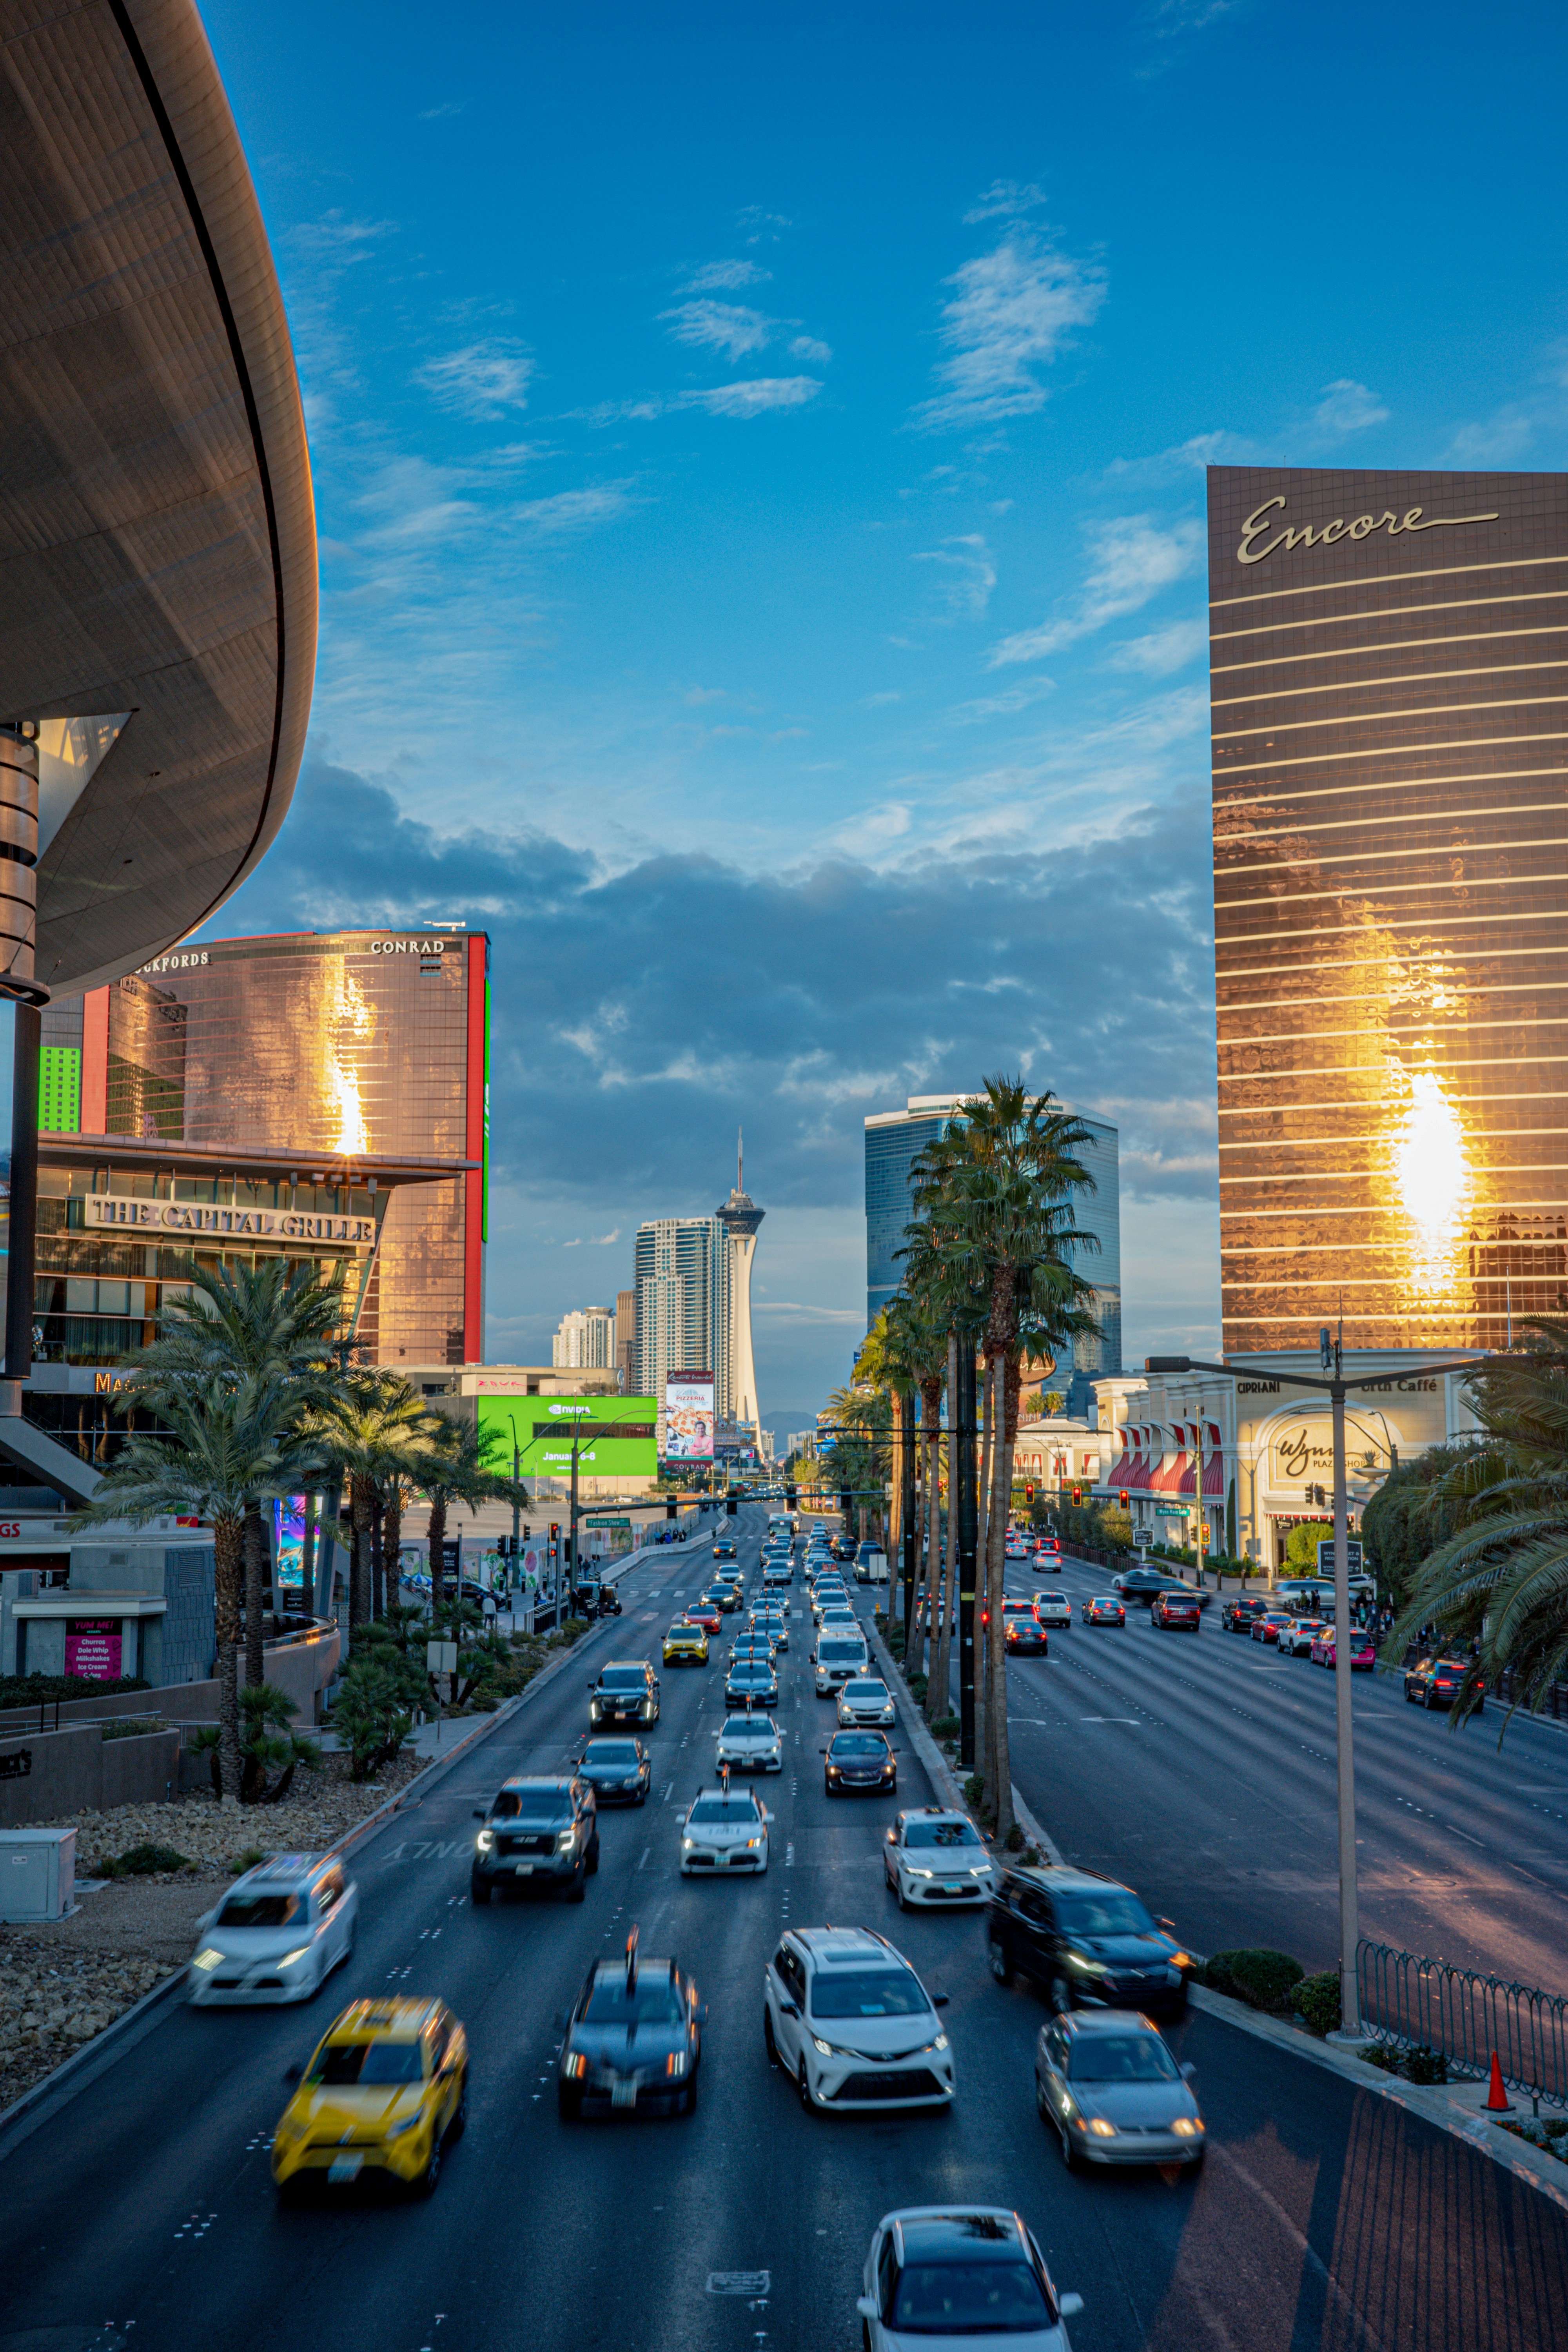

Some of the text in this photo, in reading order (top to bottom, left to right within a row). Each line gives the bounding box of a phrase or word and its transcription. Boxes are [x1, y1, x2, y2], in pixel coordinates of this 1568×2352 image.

[1238, 496, 1499, 564] Encore
[371, 941, 444, 953] CONRAD
[93, 1200, 372, 1241] THE CAPITAL GRILLE
[1238, 1382, 1280, 1394] CIPRIANI
[1397, 1379, 1437, 1391] Caffé
[75, 1621, 114, 1629] YUM ME!
[382, 1842, 475, 1859] ONLY
